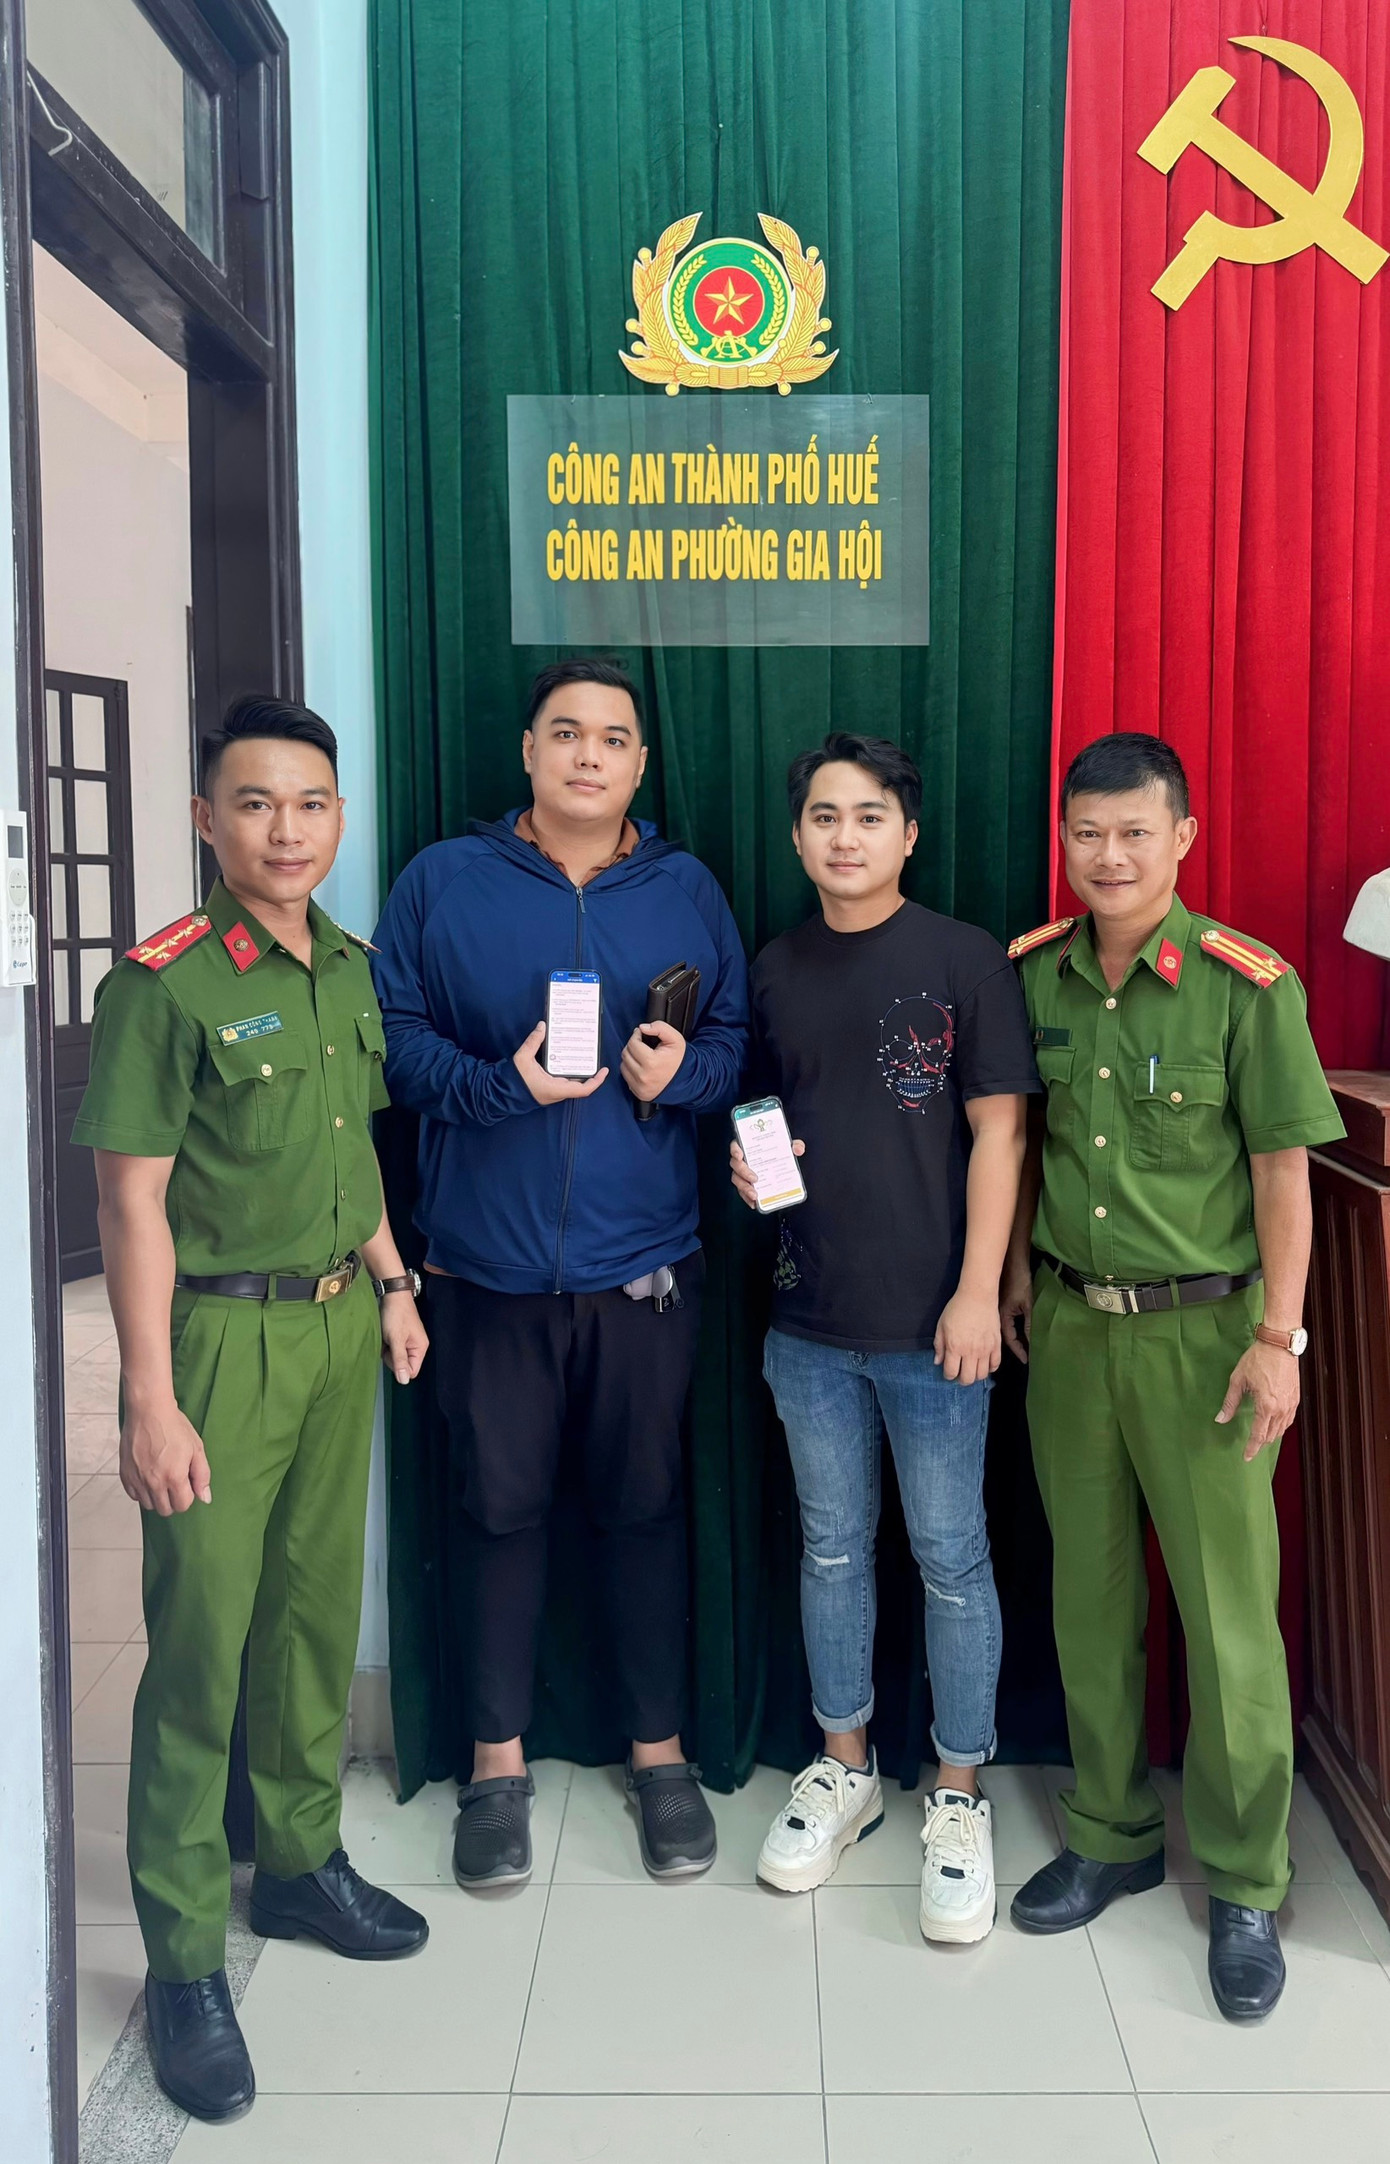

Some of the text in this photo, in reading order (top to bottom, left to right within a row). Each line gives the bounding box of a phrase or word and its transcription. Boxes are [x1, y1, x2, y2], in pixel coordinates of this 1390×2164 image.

[547, 435, 880, 506] CÔNG AN THÀNH PHỐ HUẾ
[546, 517, 882, 590] CÔNG AN PHƯỜNG GIA HỘI
